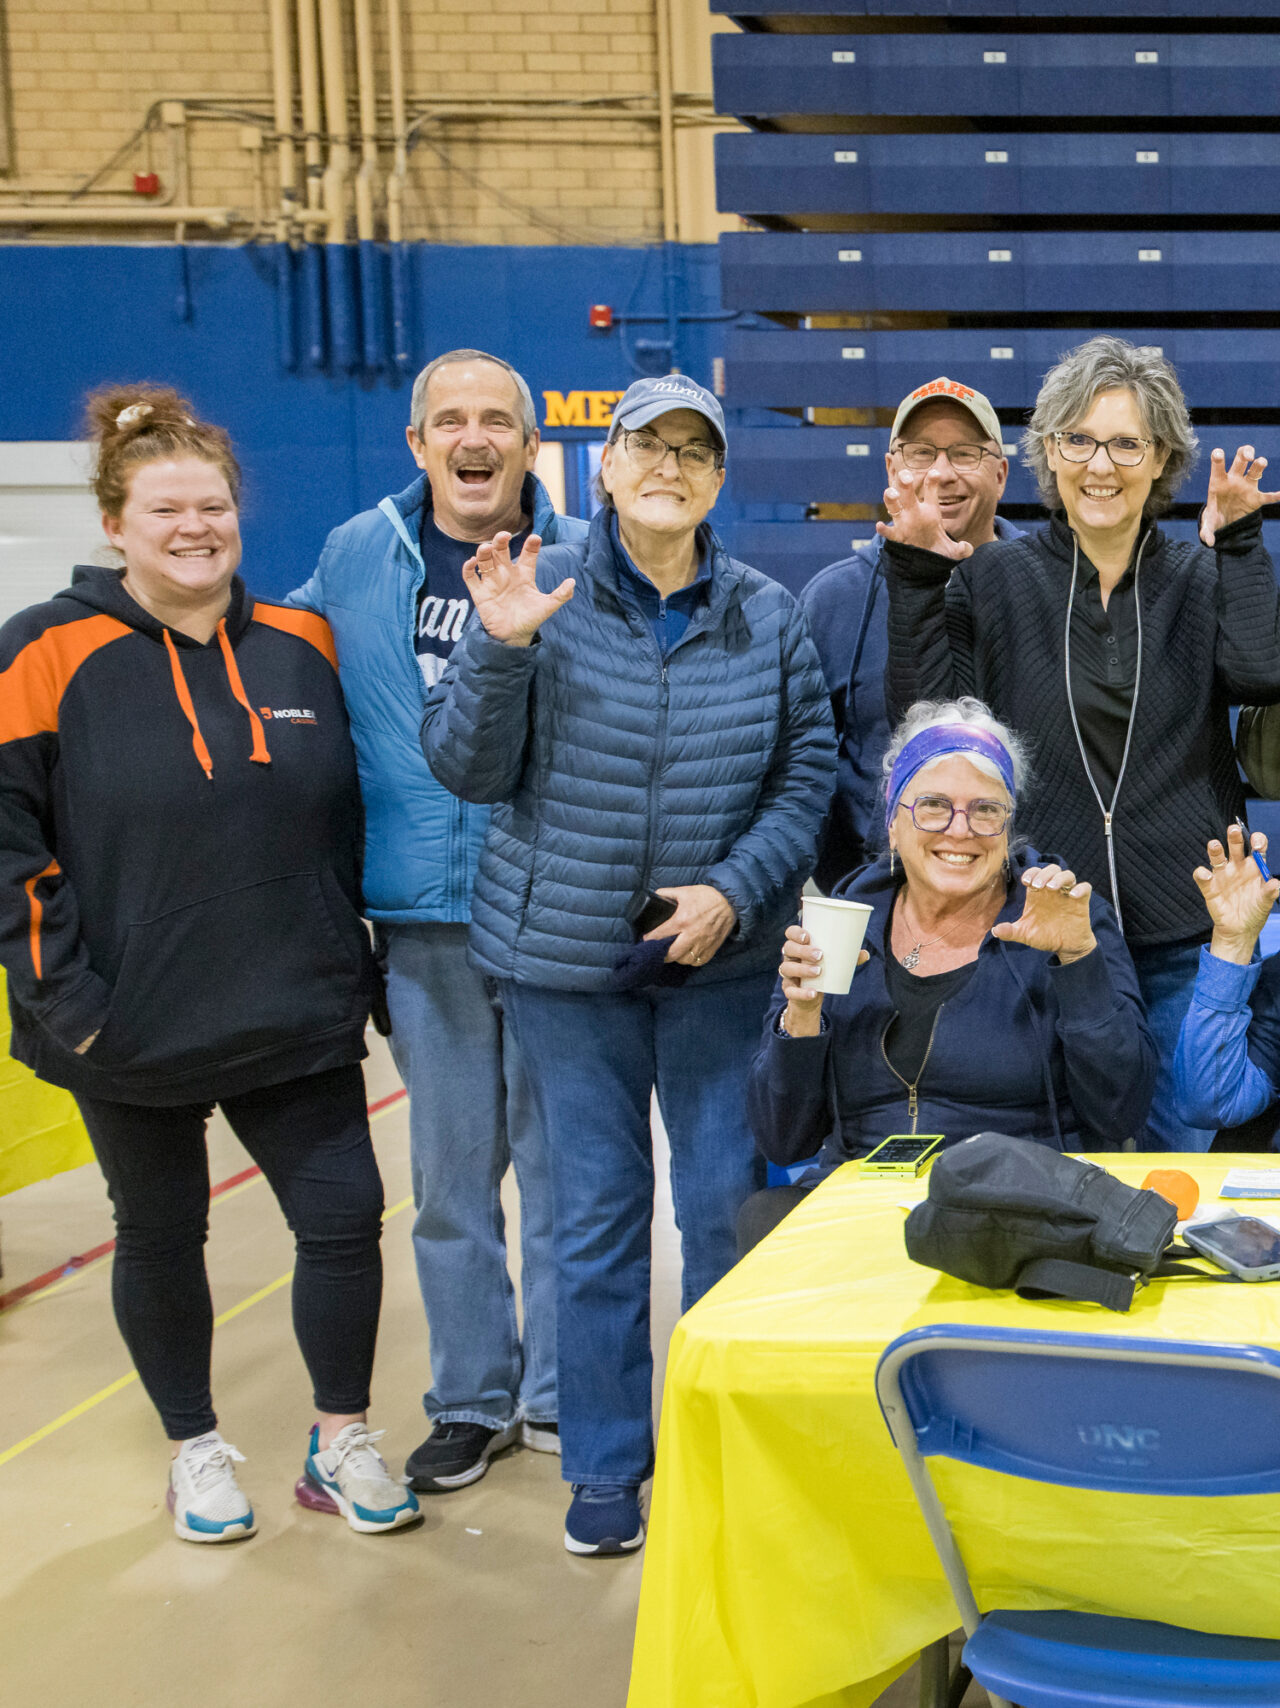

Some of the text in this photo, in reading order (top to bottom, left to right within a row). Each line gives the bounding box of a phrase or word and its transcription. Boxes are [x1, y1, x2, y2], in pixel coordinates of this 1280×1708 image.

[651, 380, 705, 401] mimi
[543, 390, 626, 427] ME
[1079, 1424, 1160, 1450] UNC
